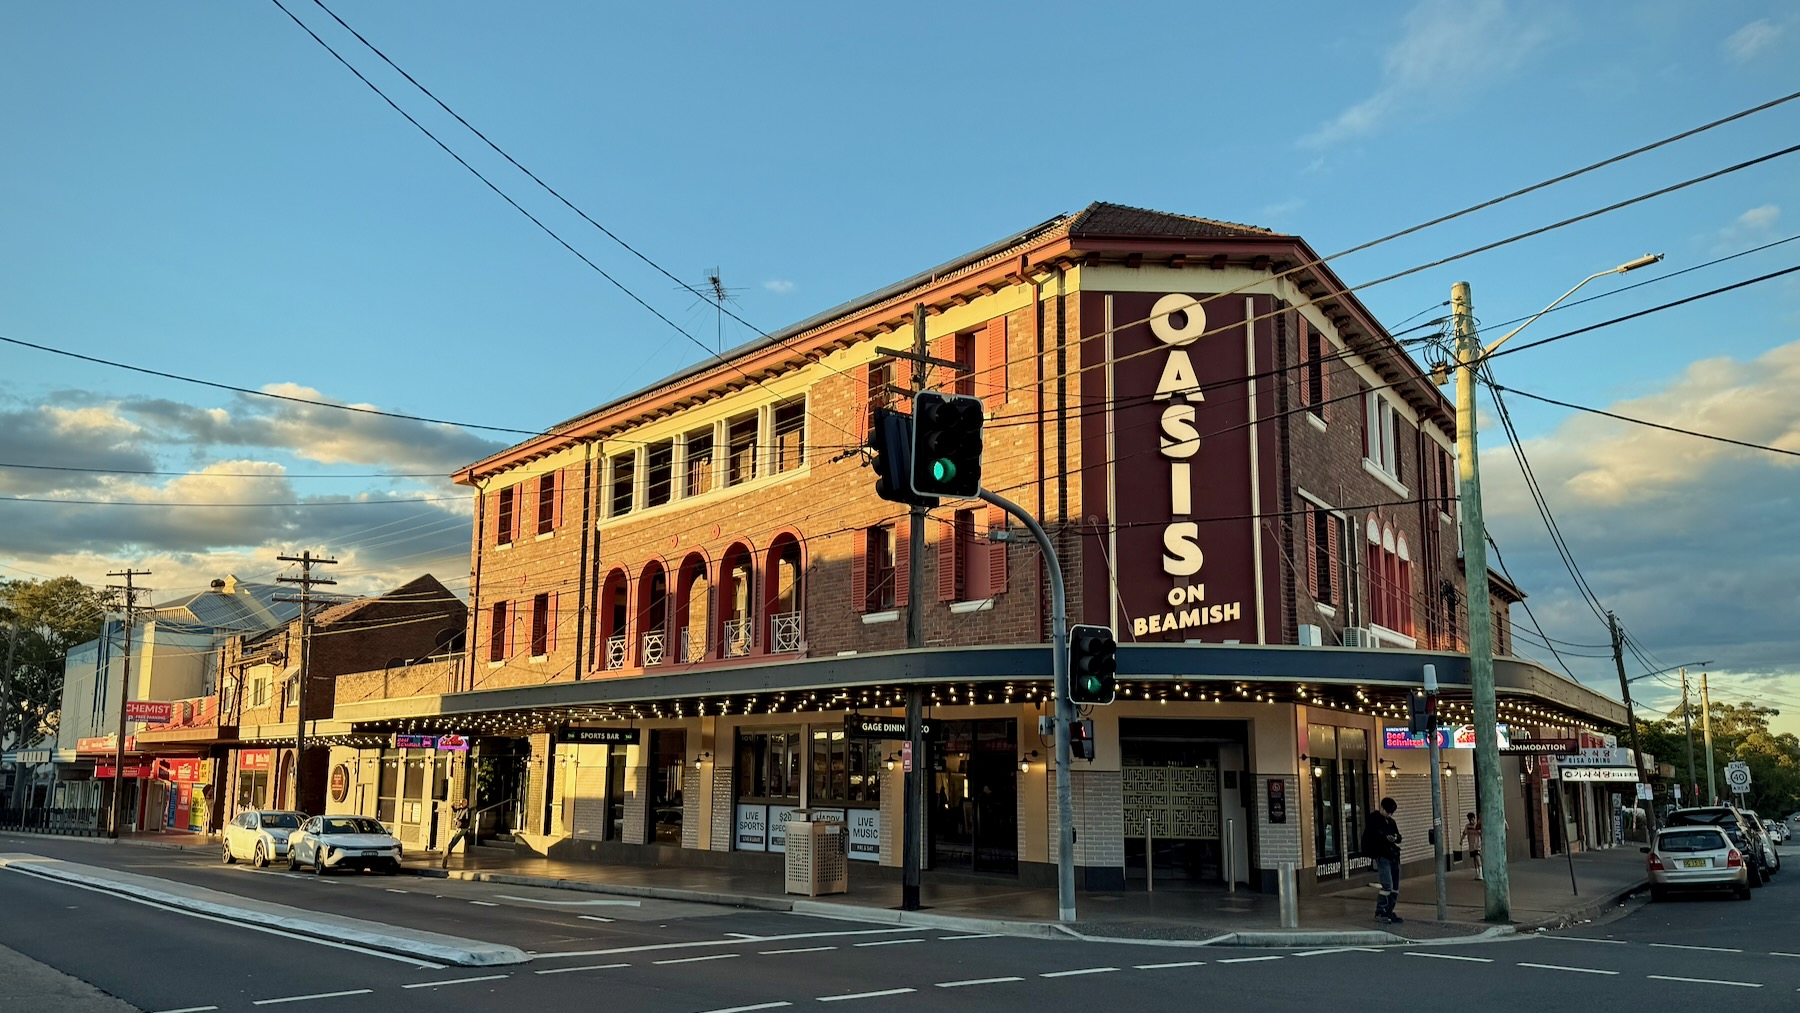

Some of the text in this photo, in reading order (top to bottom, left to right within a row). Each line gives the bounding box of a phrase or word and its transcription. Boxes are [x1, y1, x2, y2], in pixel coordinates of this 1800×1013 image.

[1150, 293, 1206, 576] OASIS
[1168, 584, 1205, 606] ON
[1134, 602, 1240, 636] BEAMISH
[126, 703, 170, 714] CHEMIST
[862, 723, 882, 731] GAGE
[884, 724, 905, 732] DININ
[607, 732, 619, 740] BAR
[746, 811, 759, 820] LIVE
[779, 812, 792, 822] $20
[740, 821, 765, 831] SPORTS
[857, 817, 874, 826] LIVE
[852, 828, 878, 839] MUSIC
[1316, 862, 1341, 876] OTTLESHOP
